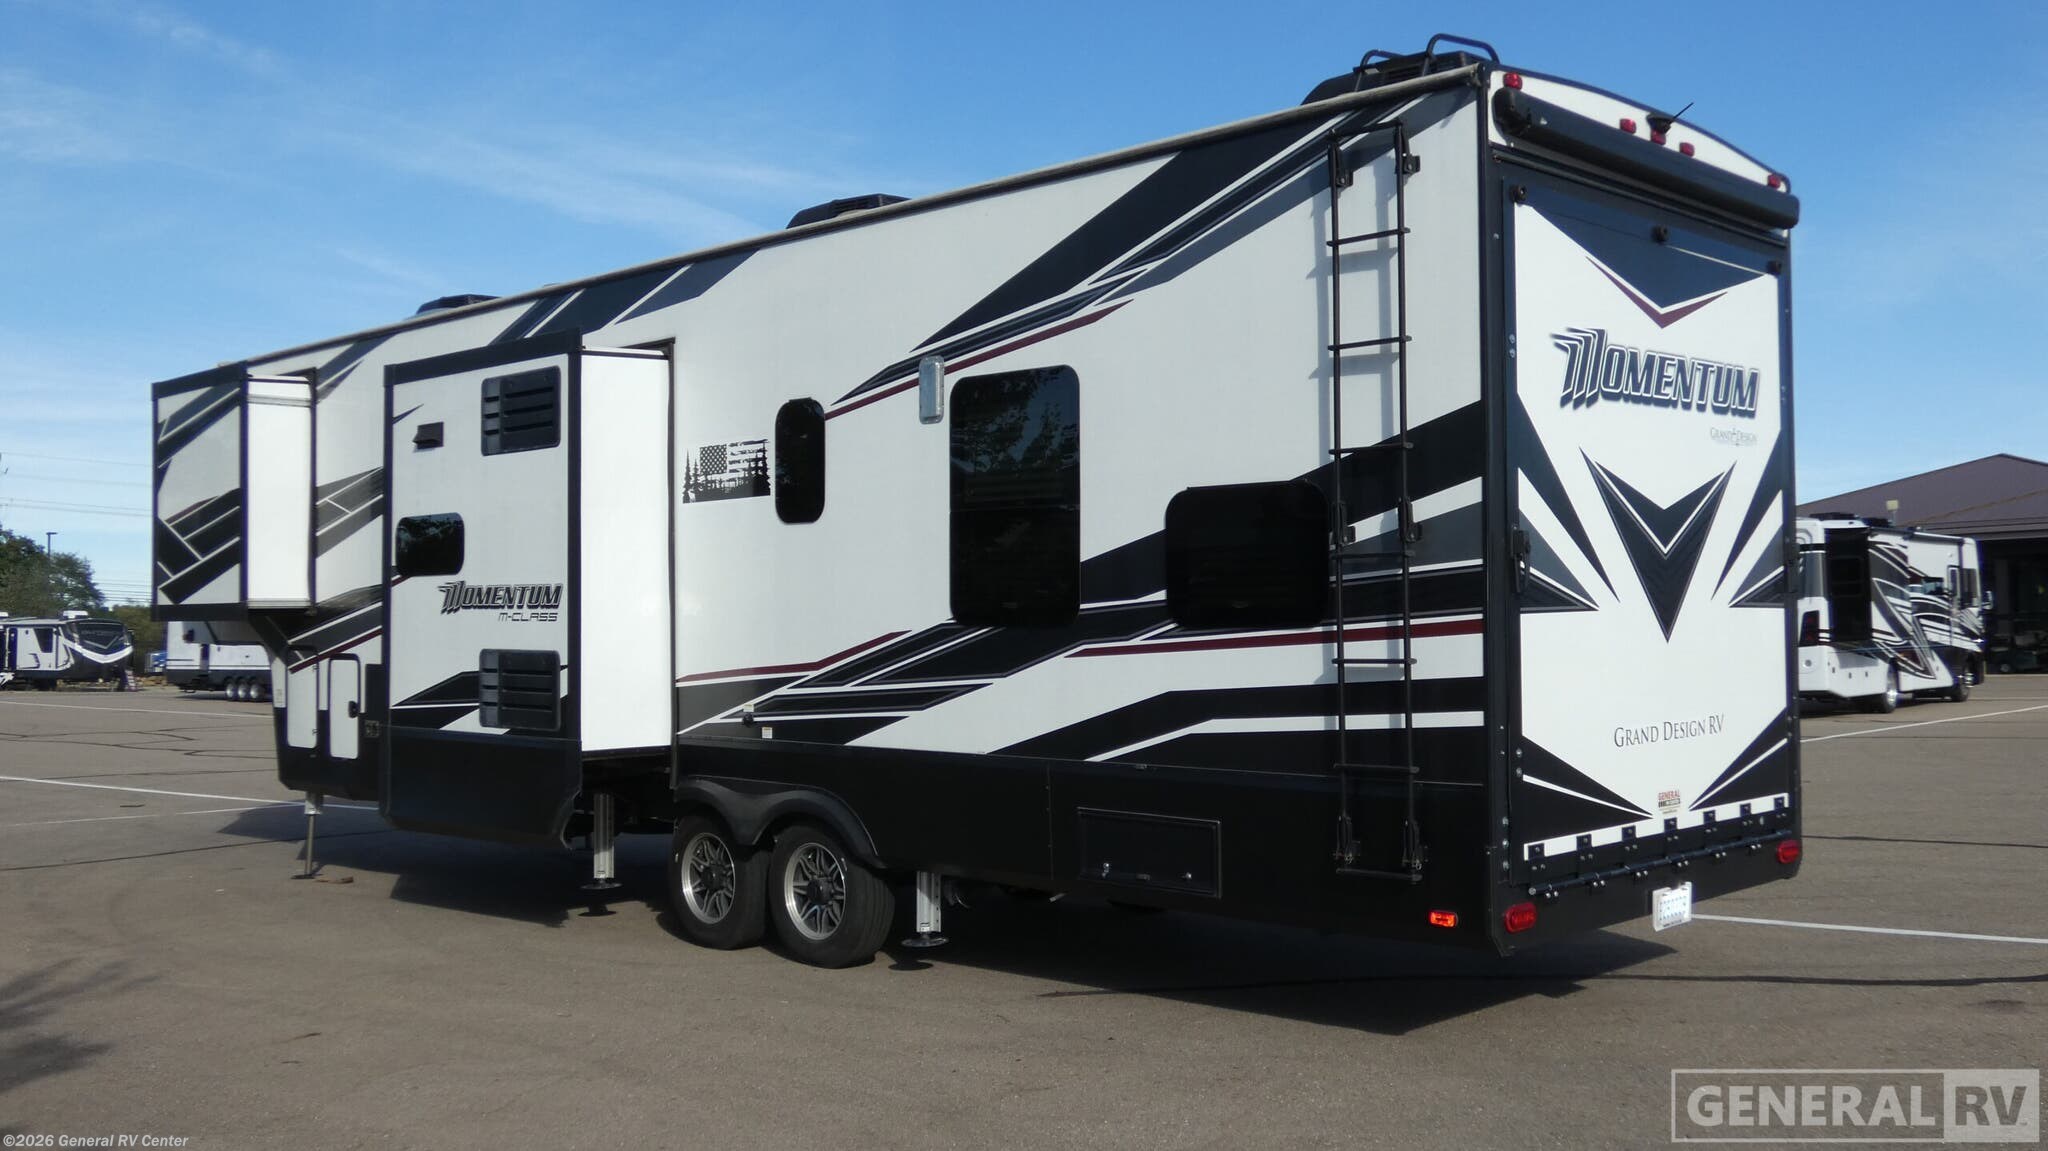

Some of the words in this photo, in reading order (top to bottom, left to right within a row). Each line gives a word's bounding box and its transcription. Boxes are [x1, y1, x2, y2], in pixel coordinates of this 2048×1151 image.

[1549, 327, 1761, 419] MOMENTUM
[437, 580, 563, 614] MOMENTUM
[1709, 713, 1724, 735] RV
